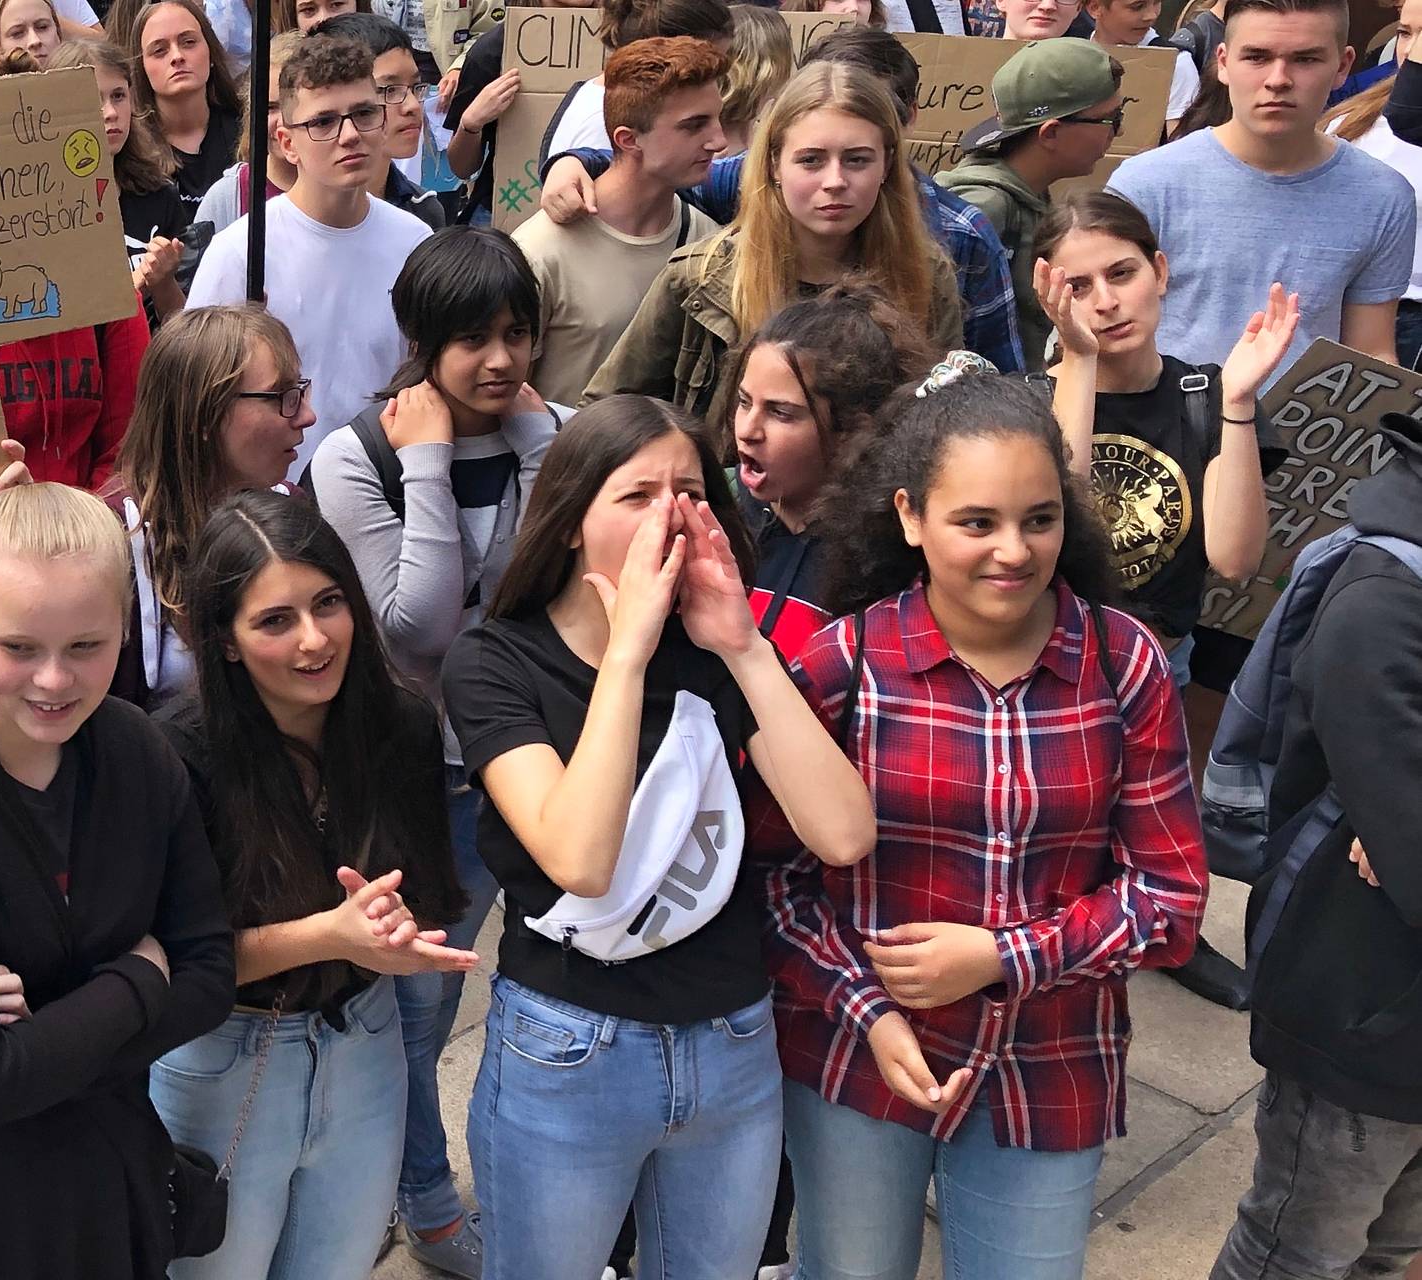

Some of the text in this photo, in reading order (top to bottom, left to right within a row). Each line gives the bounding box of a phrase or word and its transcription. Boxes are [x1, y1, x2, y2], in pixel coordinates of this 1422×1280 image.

[517, 14, 604, 70] CLIM
[12, 90, 60, 144] die
[1294, 362, 1400, 413] AT
